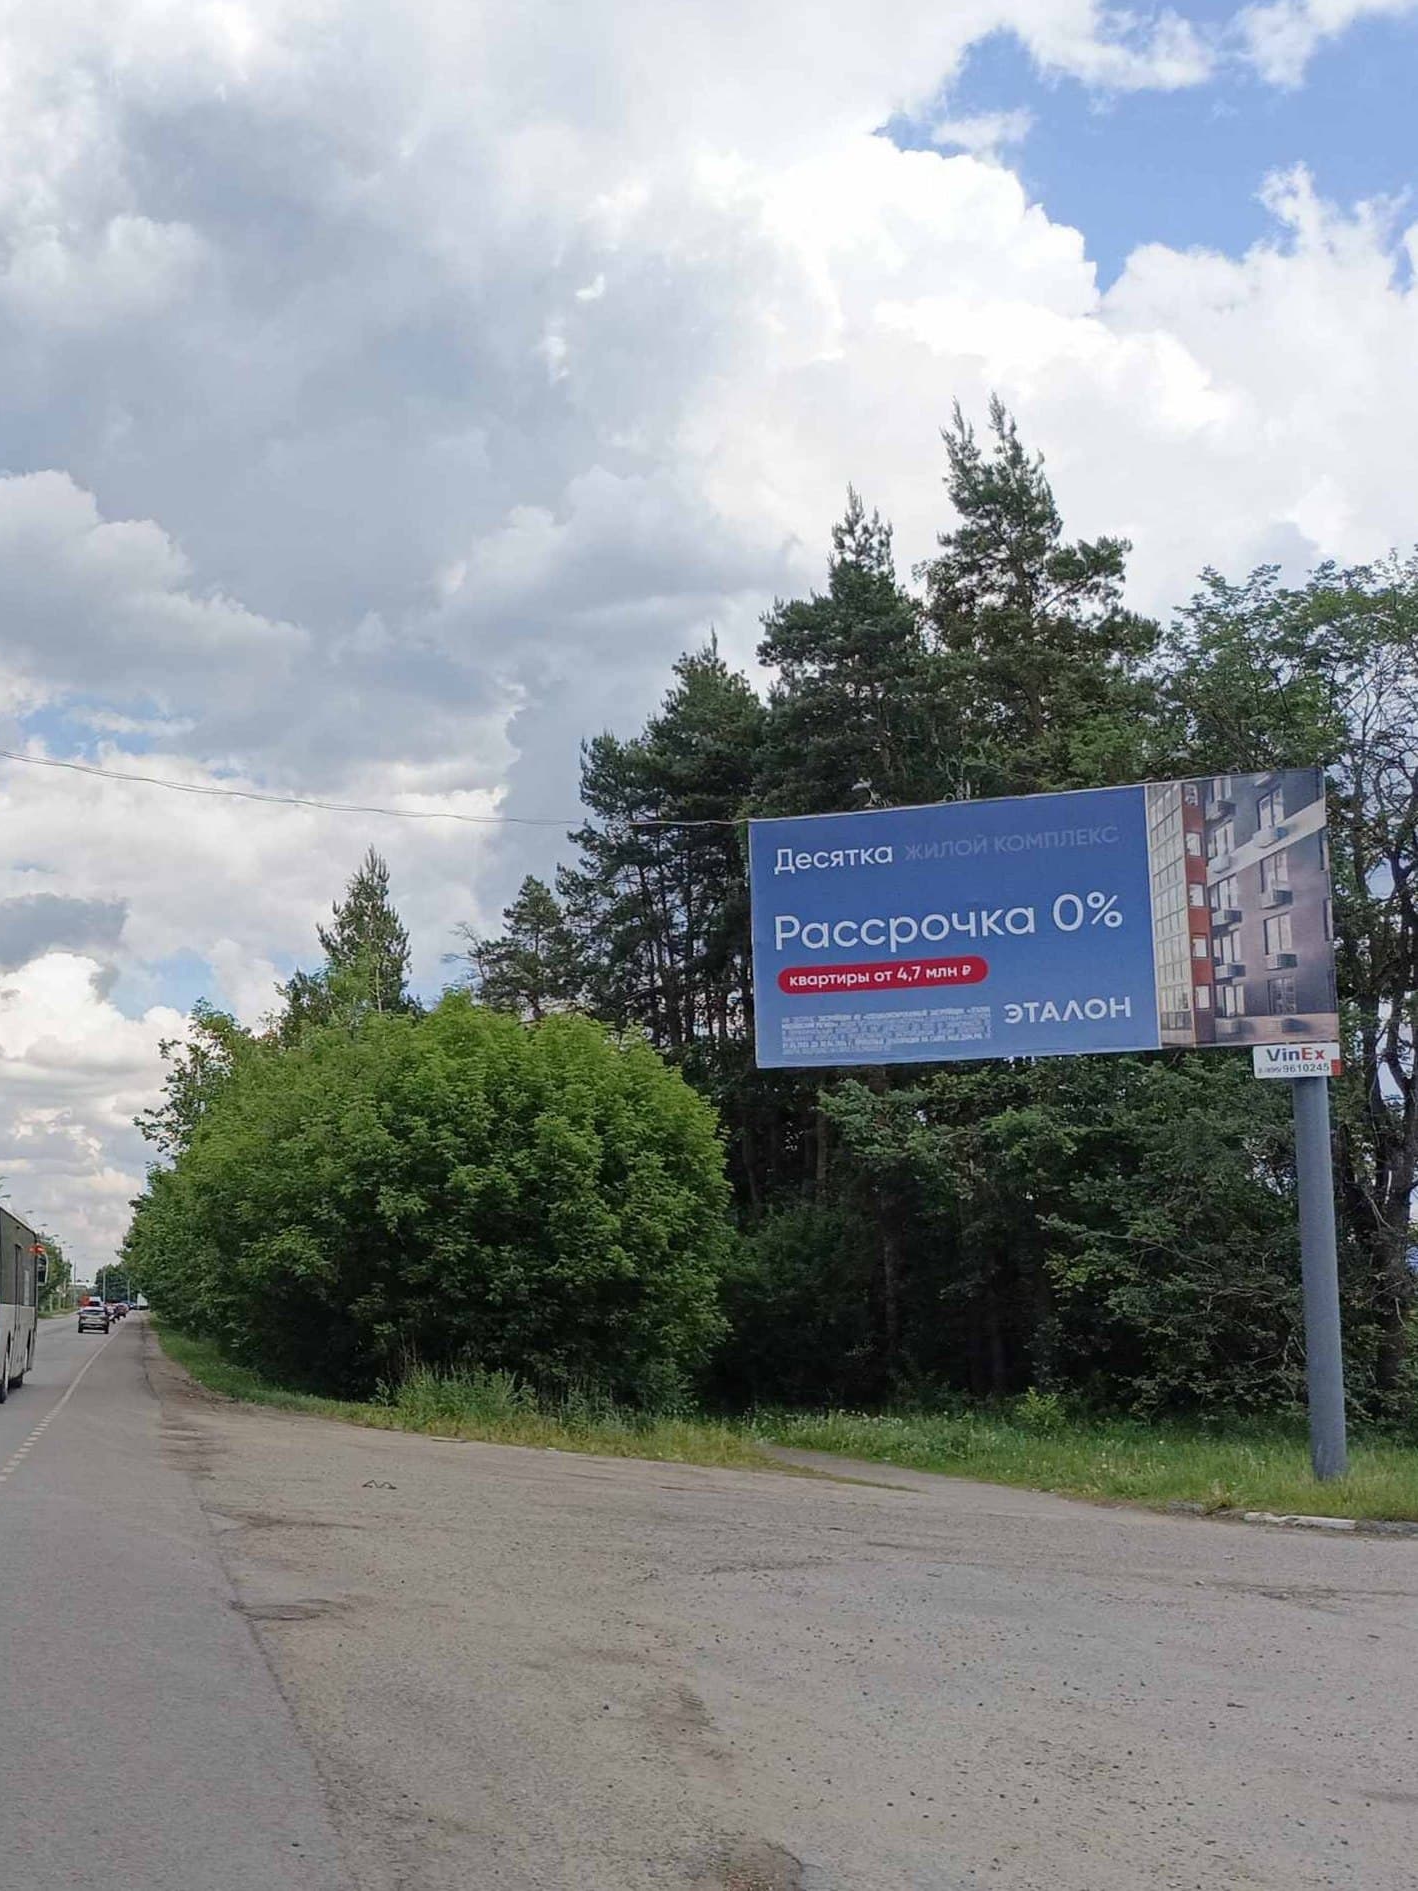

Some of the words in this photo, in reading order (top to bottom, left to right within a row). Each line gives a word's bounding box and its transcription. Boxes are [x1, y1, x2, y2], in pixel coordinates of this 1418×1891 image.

[773, 845, 894, 875] Десятка
[994, 826, 1120, 853] КОМПЛЕКС
[774, 906, 1036, 953] Рассрочка
[1052, 891, 1124, 932] 0%
[789, 972, 870, 988] квартиры
[873, 970, 893, 983] от
[896, 966, 922, 982] 4,7
[925, 966, 958, 979] млн
[1003, 996, 1132, 1024] ЭТАЛОН
[1266, 1047, 1325, 1062] VinEx
